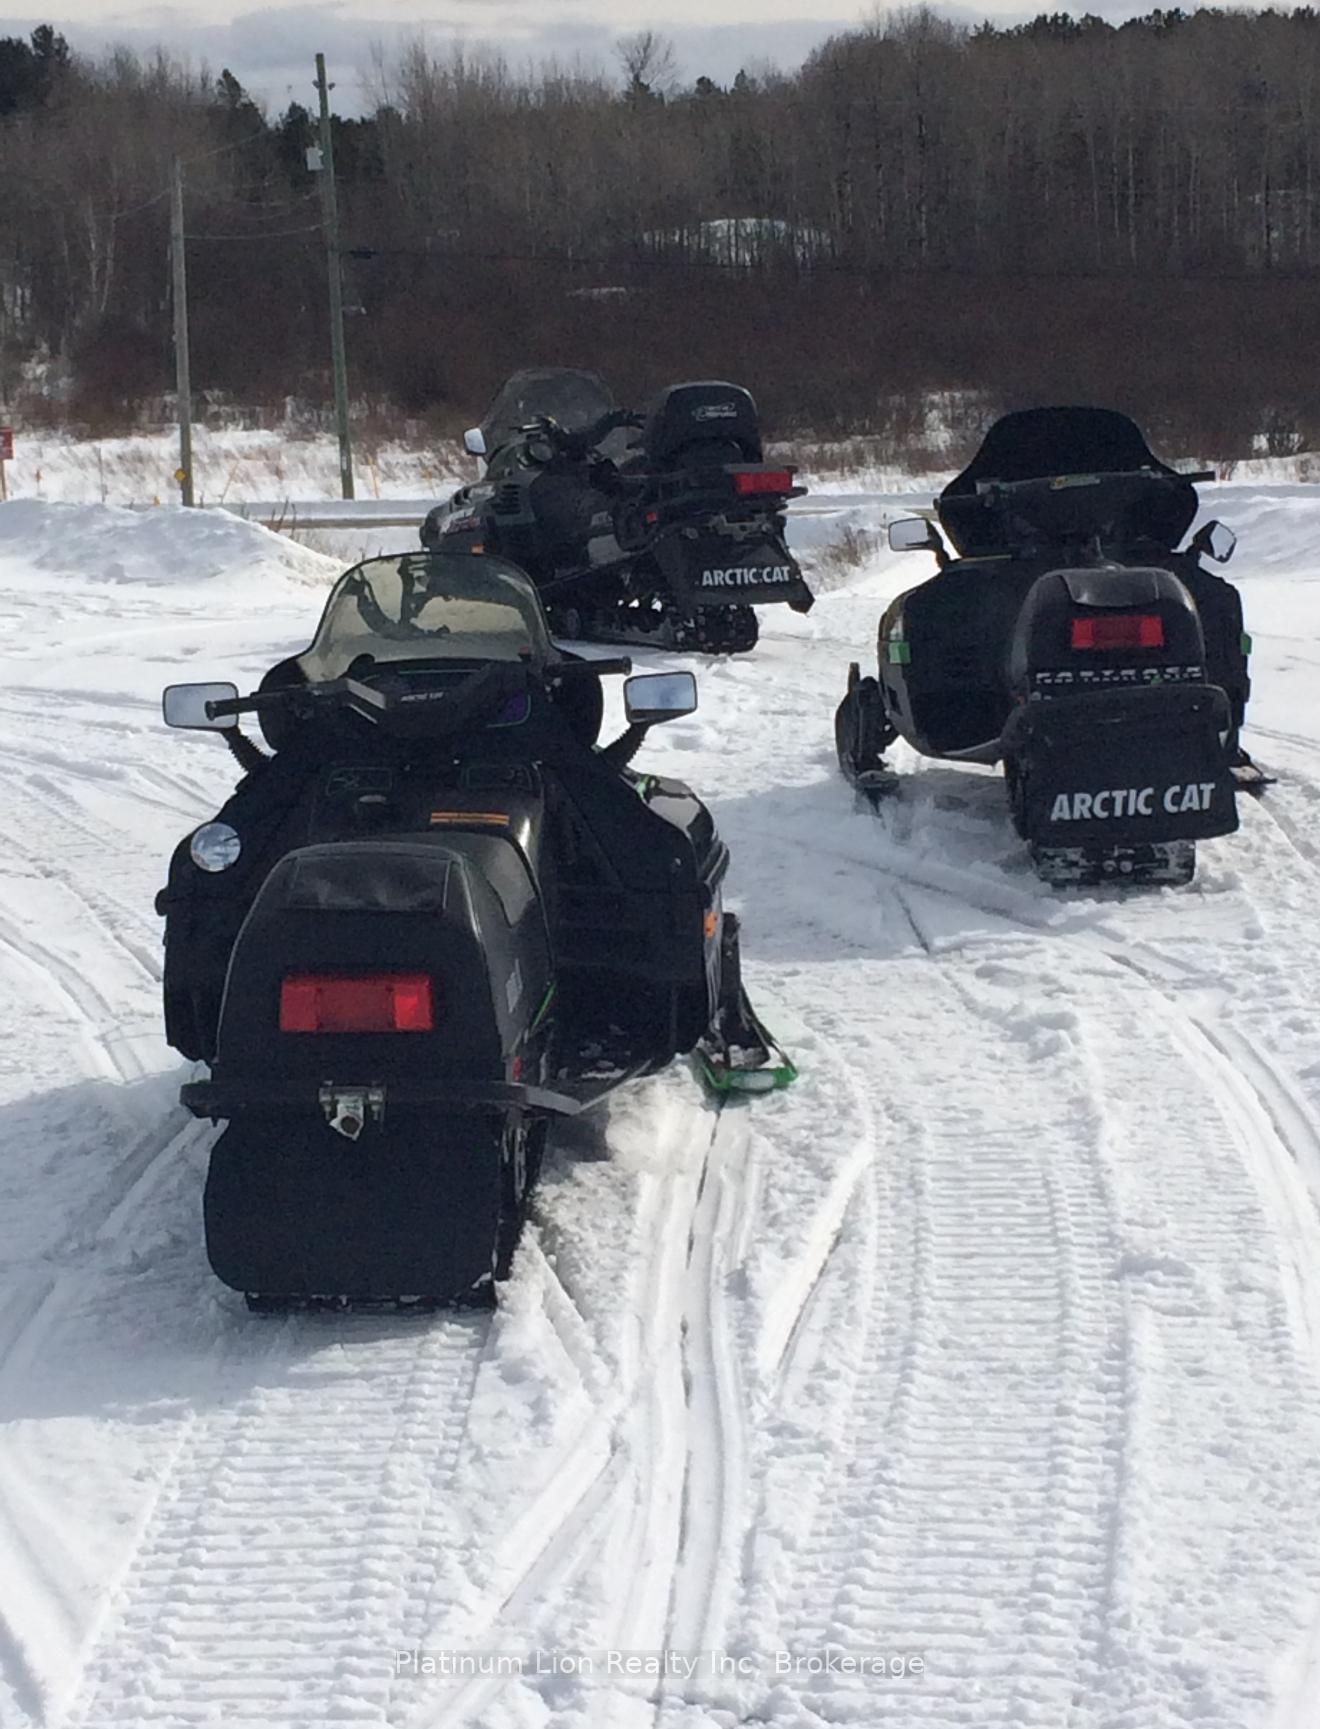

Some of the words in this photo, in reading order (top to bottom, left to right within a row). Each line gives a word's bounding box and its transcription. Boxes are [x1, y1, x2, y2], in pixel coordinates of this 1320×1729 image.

[701, 567, 758, 587] ARCTIC
[762, 565, 791, 584] CAT
[1050, 787, 1154, 822] ARCTIC
[1163, 782, 1216, 814] CAT
